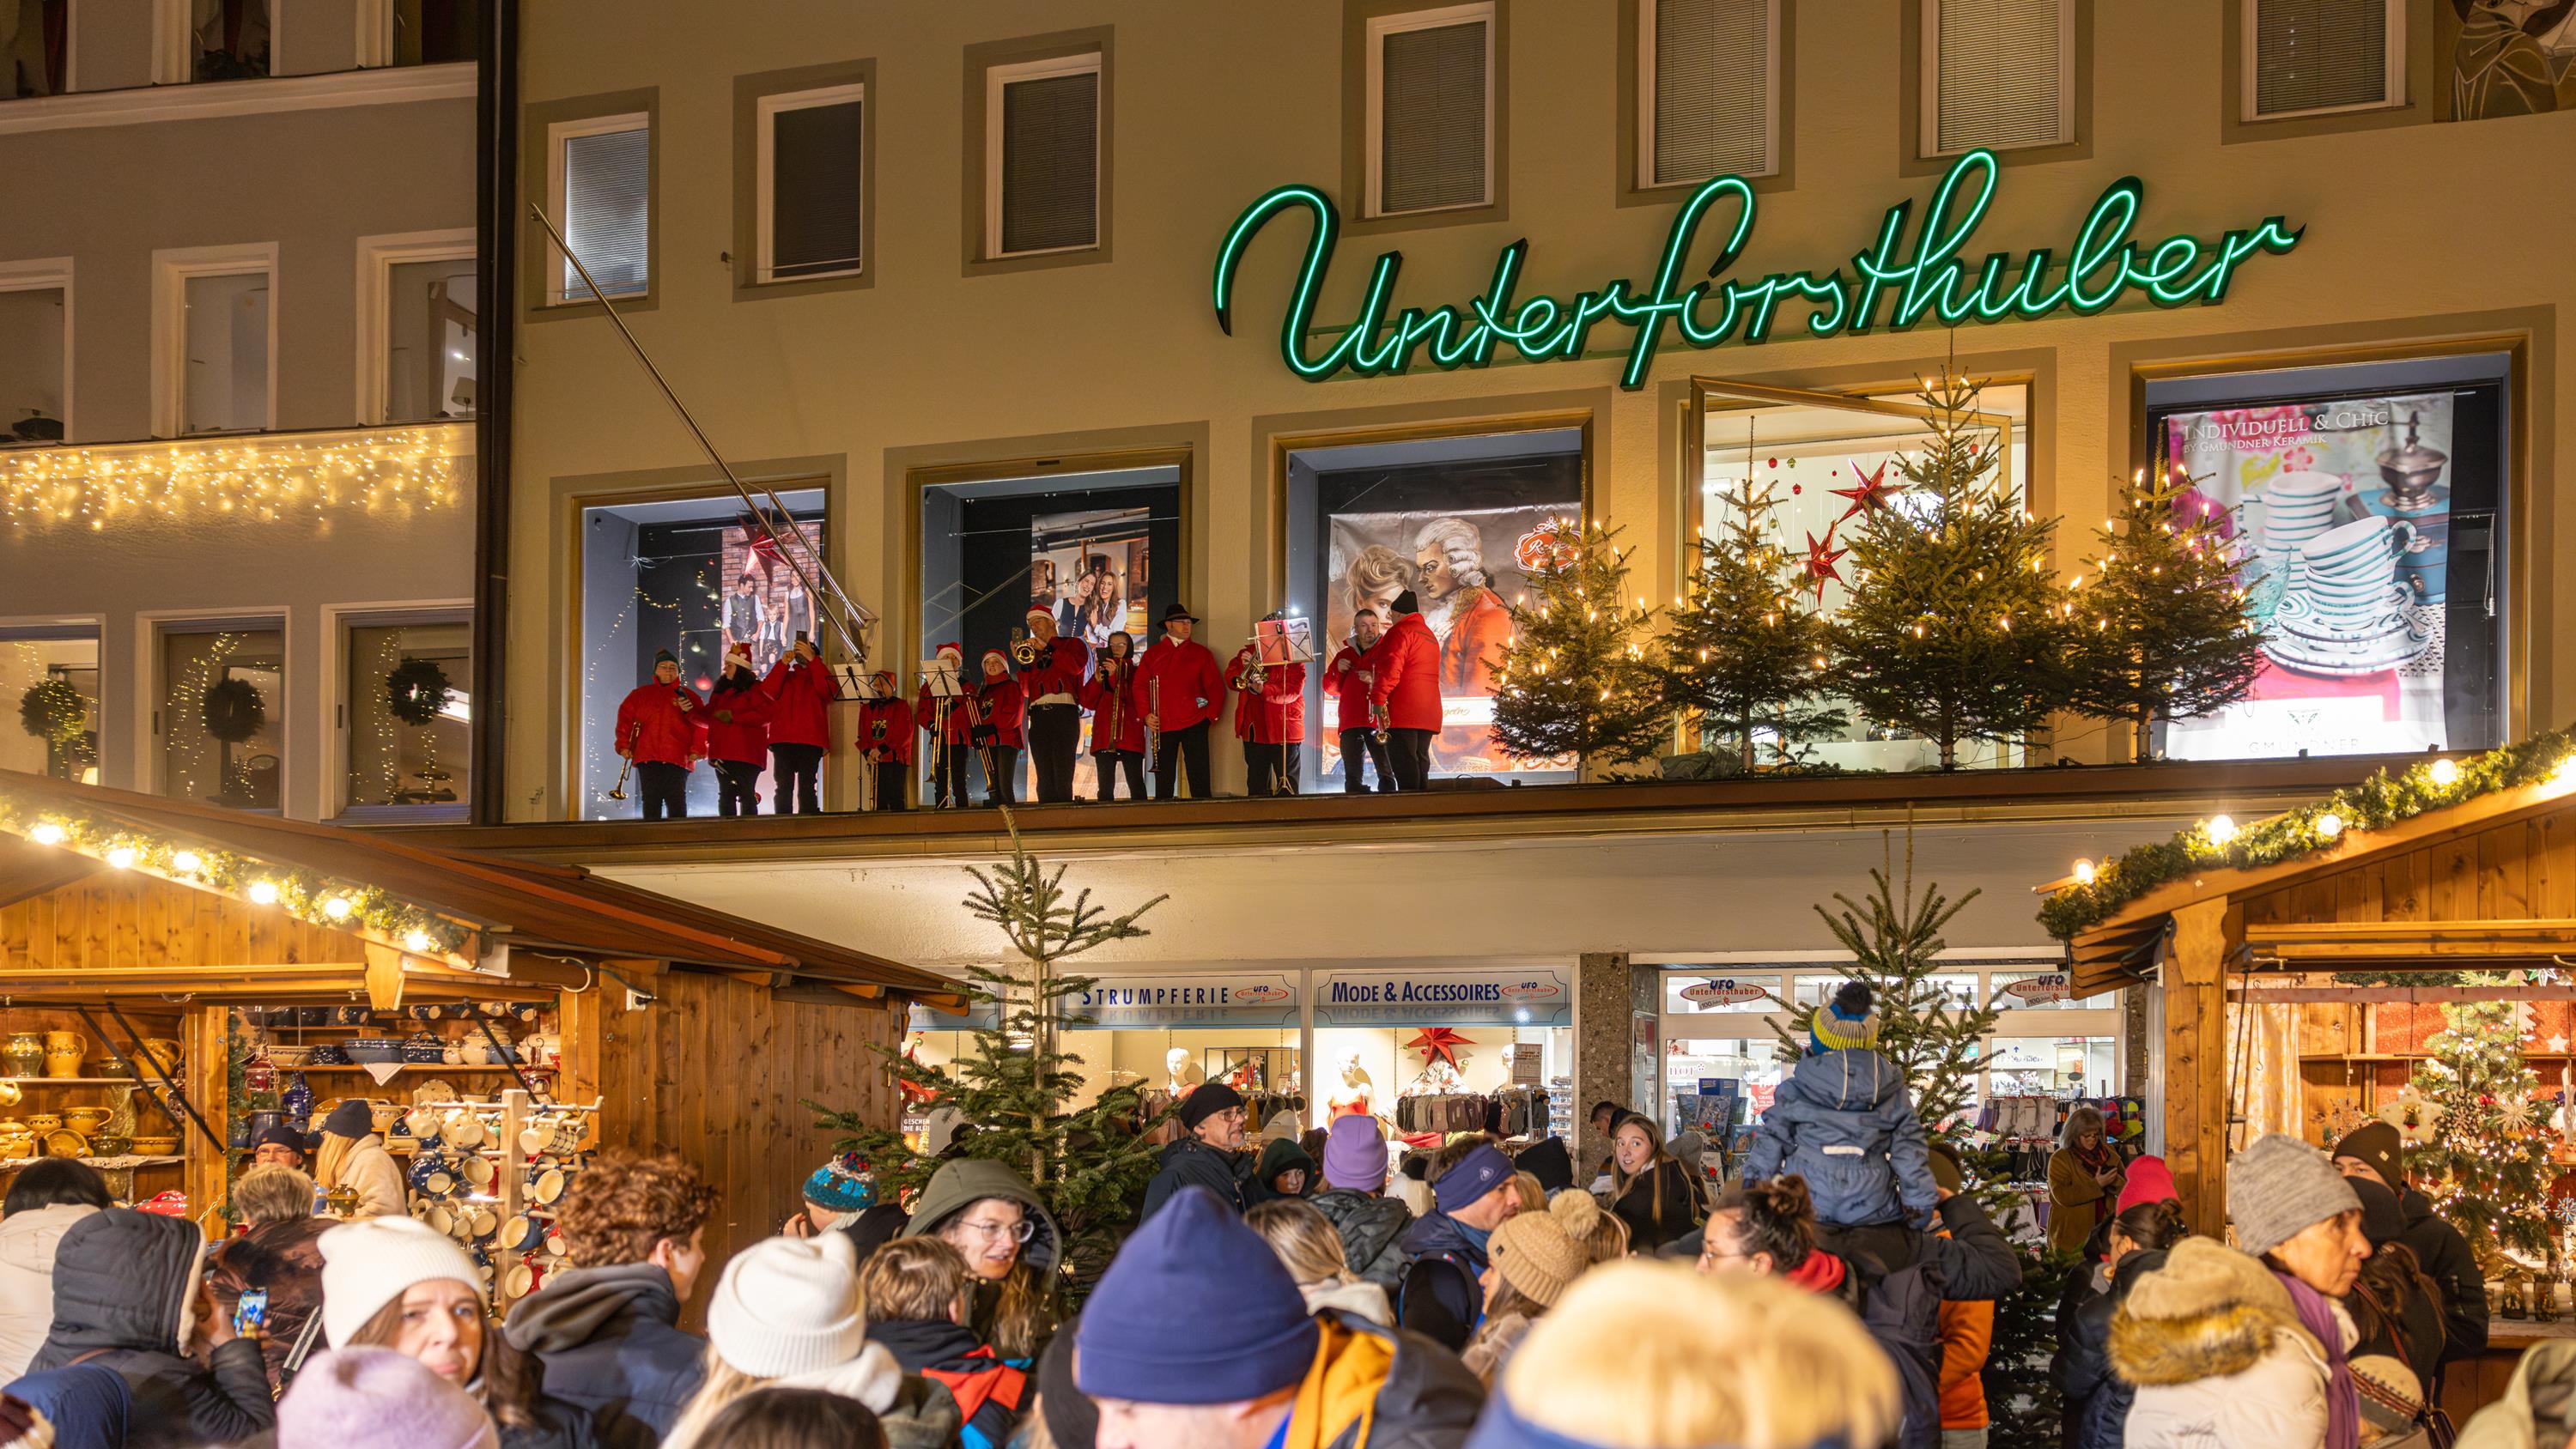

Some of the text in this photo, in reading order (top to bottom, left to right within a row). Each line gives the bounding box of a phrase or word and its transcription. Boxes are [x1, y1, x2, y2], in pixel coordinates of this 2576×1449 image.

[1213, 147, 2306, 391] Unterforsthuber
[2184, 412, 2389, 440] INDIVIDUELL & CHIC
[2184, 434, 2327, 454] BY GMUNDNER KERAMIK
[2249, 739, 2359, 753] GMUNDNER
[1710, 979, 1735, 990] UFO
[2015, 983, 2069, 991] Unterforsth
[2038, 974, 2065, 985] UFO
[1082, 987, 1228, 1005] STRUMPFERIE
[1332, 981, 1500, 1003] MODE & ACCESSOIRES
[1690, 987, 1759, 996] Unterforsthuber
